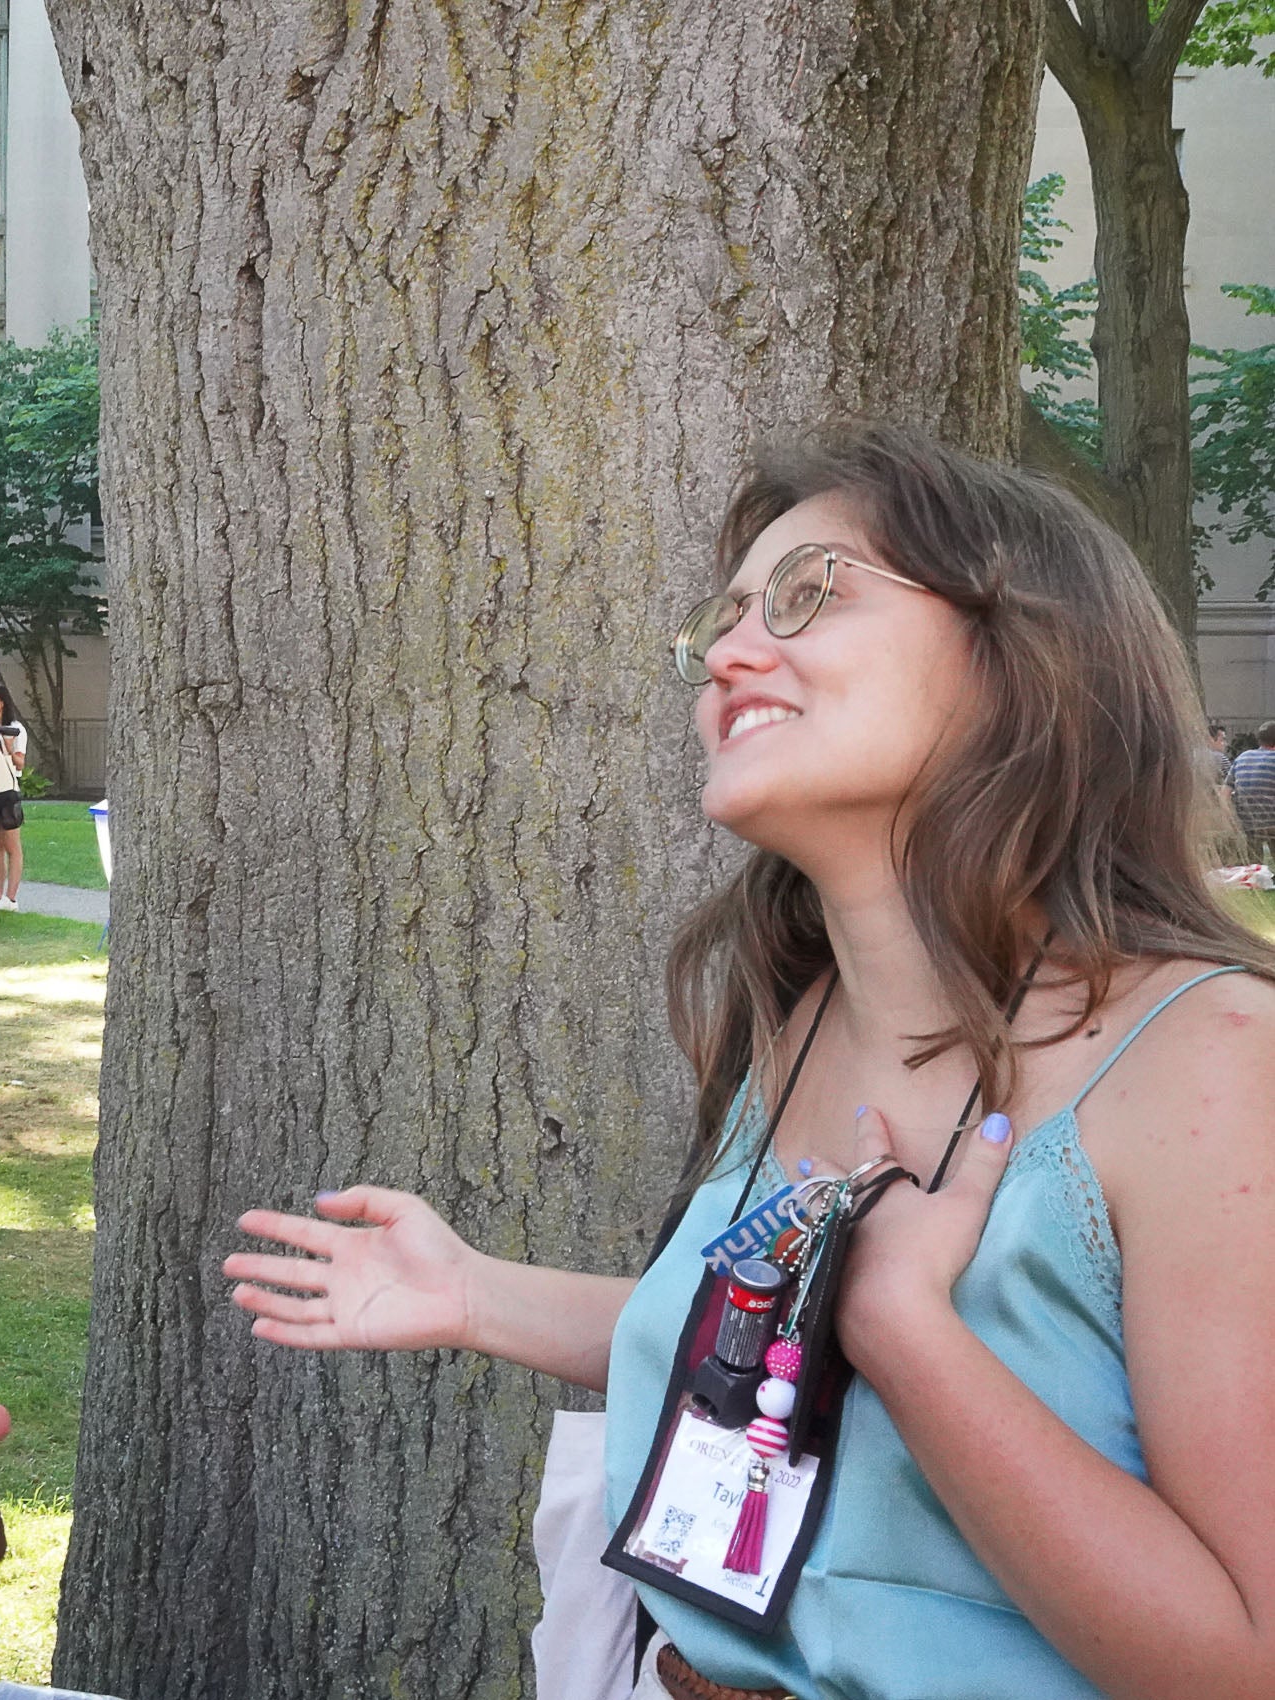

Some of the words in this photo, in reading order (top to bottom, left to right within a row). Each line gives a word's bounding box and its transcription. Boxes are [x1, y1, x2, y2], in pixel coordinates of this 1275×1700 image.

[775, 1470, 801, 1489] 2022
[713, 1481, 745, 1509] Tayl
[755, 1574, 770, 1598] 1
